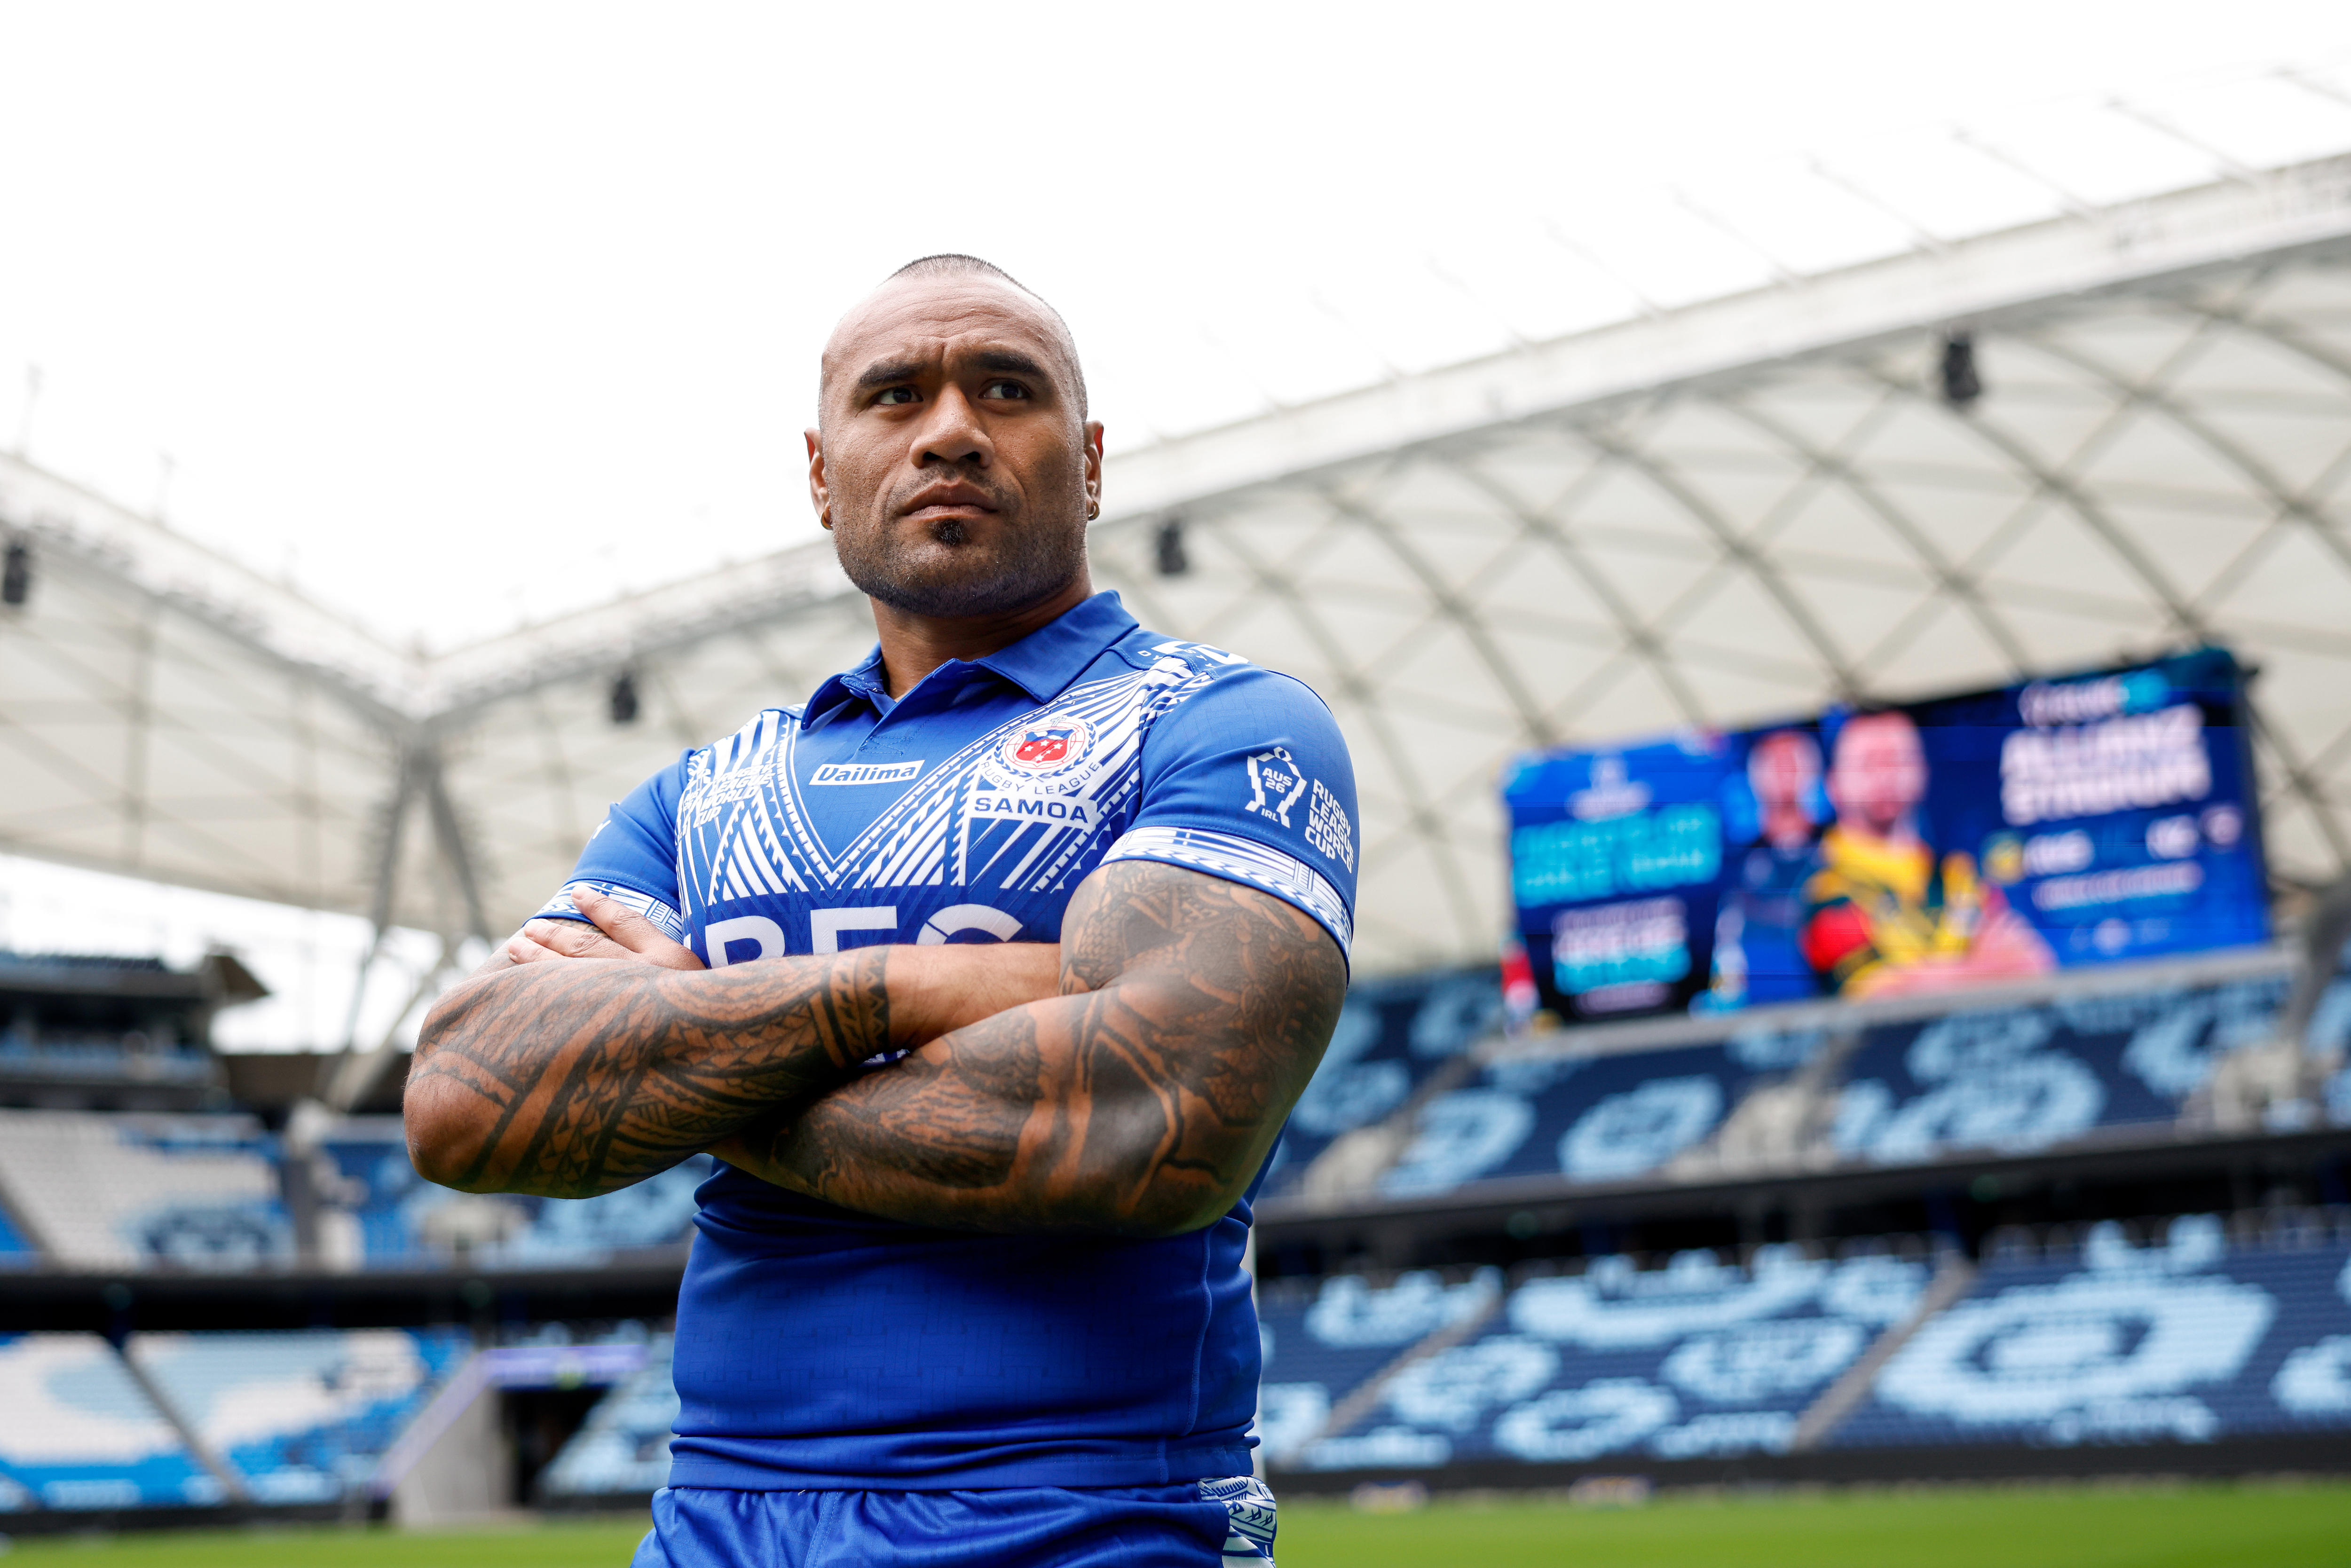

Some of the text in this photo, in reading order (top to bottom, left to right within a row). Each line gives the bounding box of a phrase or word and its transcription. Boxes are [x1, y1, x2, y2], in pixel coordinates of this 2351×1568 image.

[818, 766, 916, 781] Vailima
[981, 762, 1099, 795] RUGBY LEAGUE
[1262, 767, 1293, 786] AUS
[1265, 777, 1285, 793] 26
[700, 786, 759, 811] WORLD
[974, 797, 1088, 823] SAMOA
[1313, 778, 1351, 837] RUGBY
[693, 805, 722, 828] CUP
[1261, 808, 1278, 822] IRL
[1309, 809, 1352, 874] WORLD
[1310, 793, 1354, 865] LEAGUE
[1305, 826, 1335, 859] CUP
